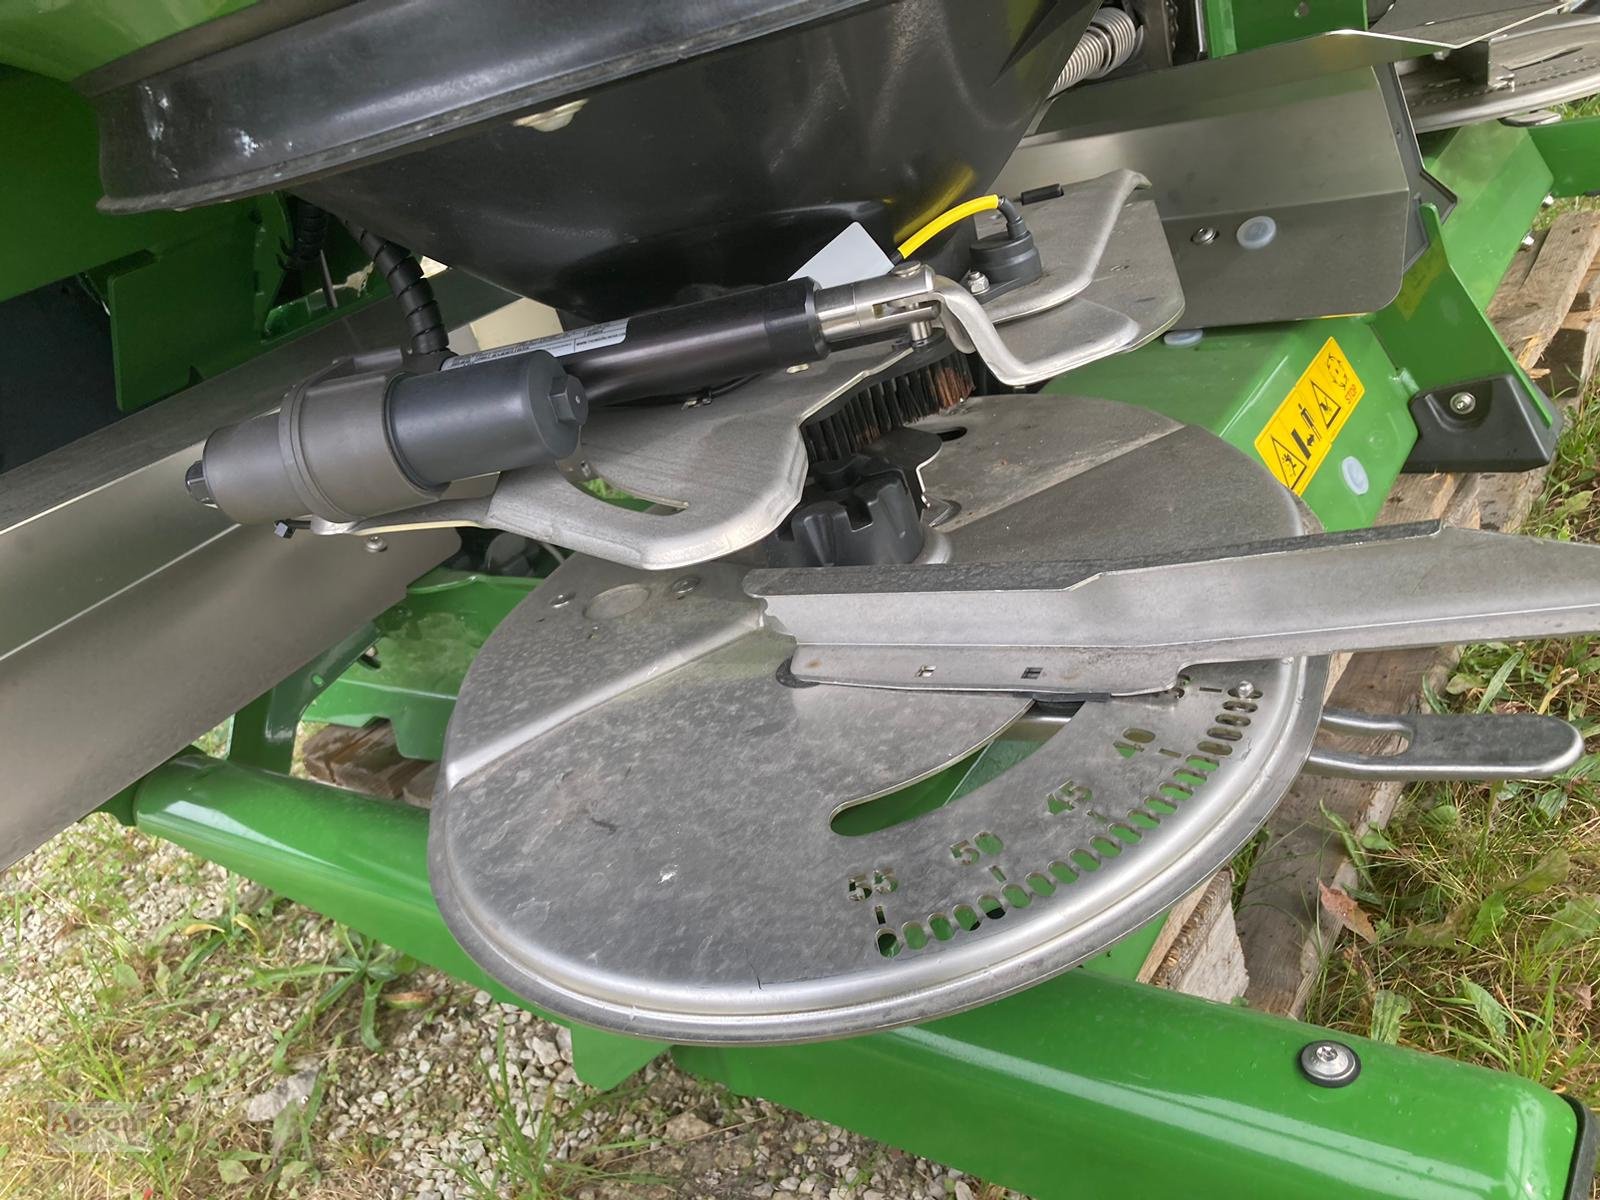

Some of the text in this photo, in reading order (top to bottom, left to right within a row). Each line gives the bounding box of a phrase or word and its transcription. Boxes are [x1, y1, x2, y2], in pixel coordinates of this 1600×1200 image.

[1113, 727, 1156, 759] 40
[1046, 778, 1093, 815] 45
[950, 831, 1004, 865] 50
[848, 868, 899, 901] 55
